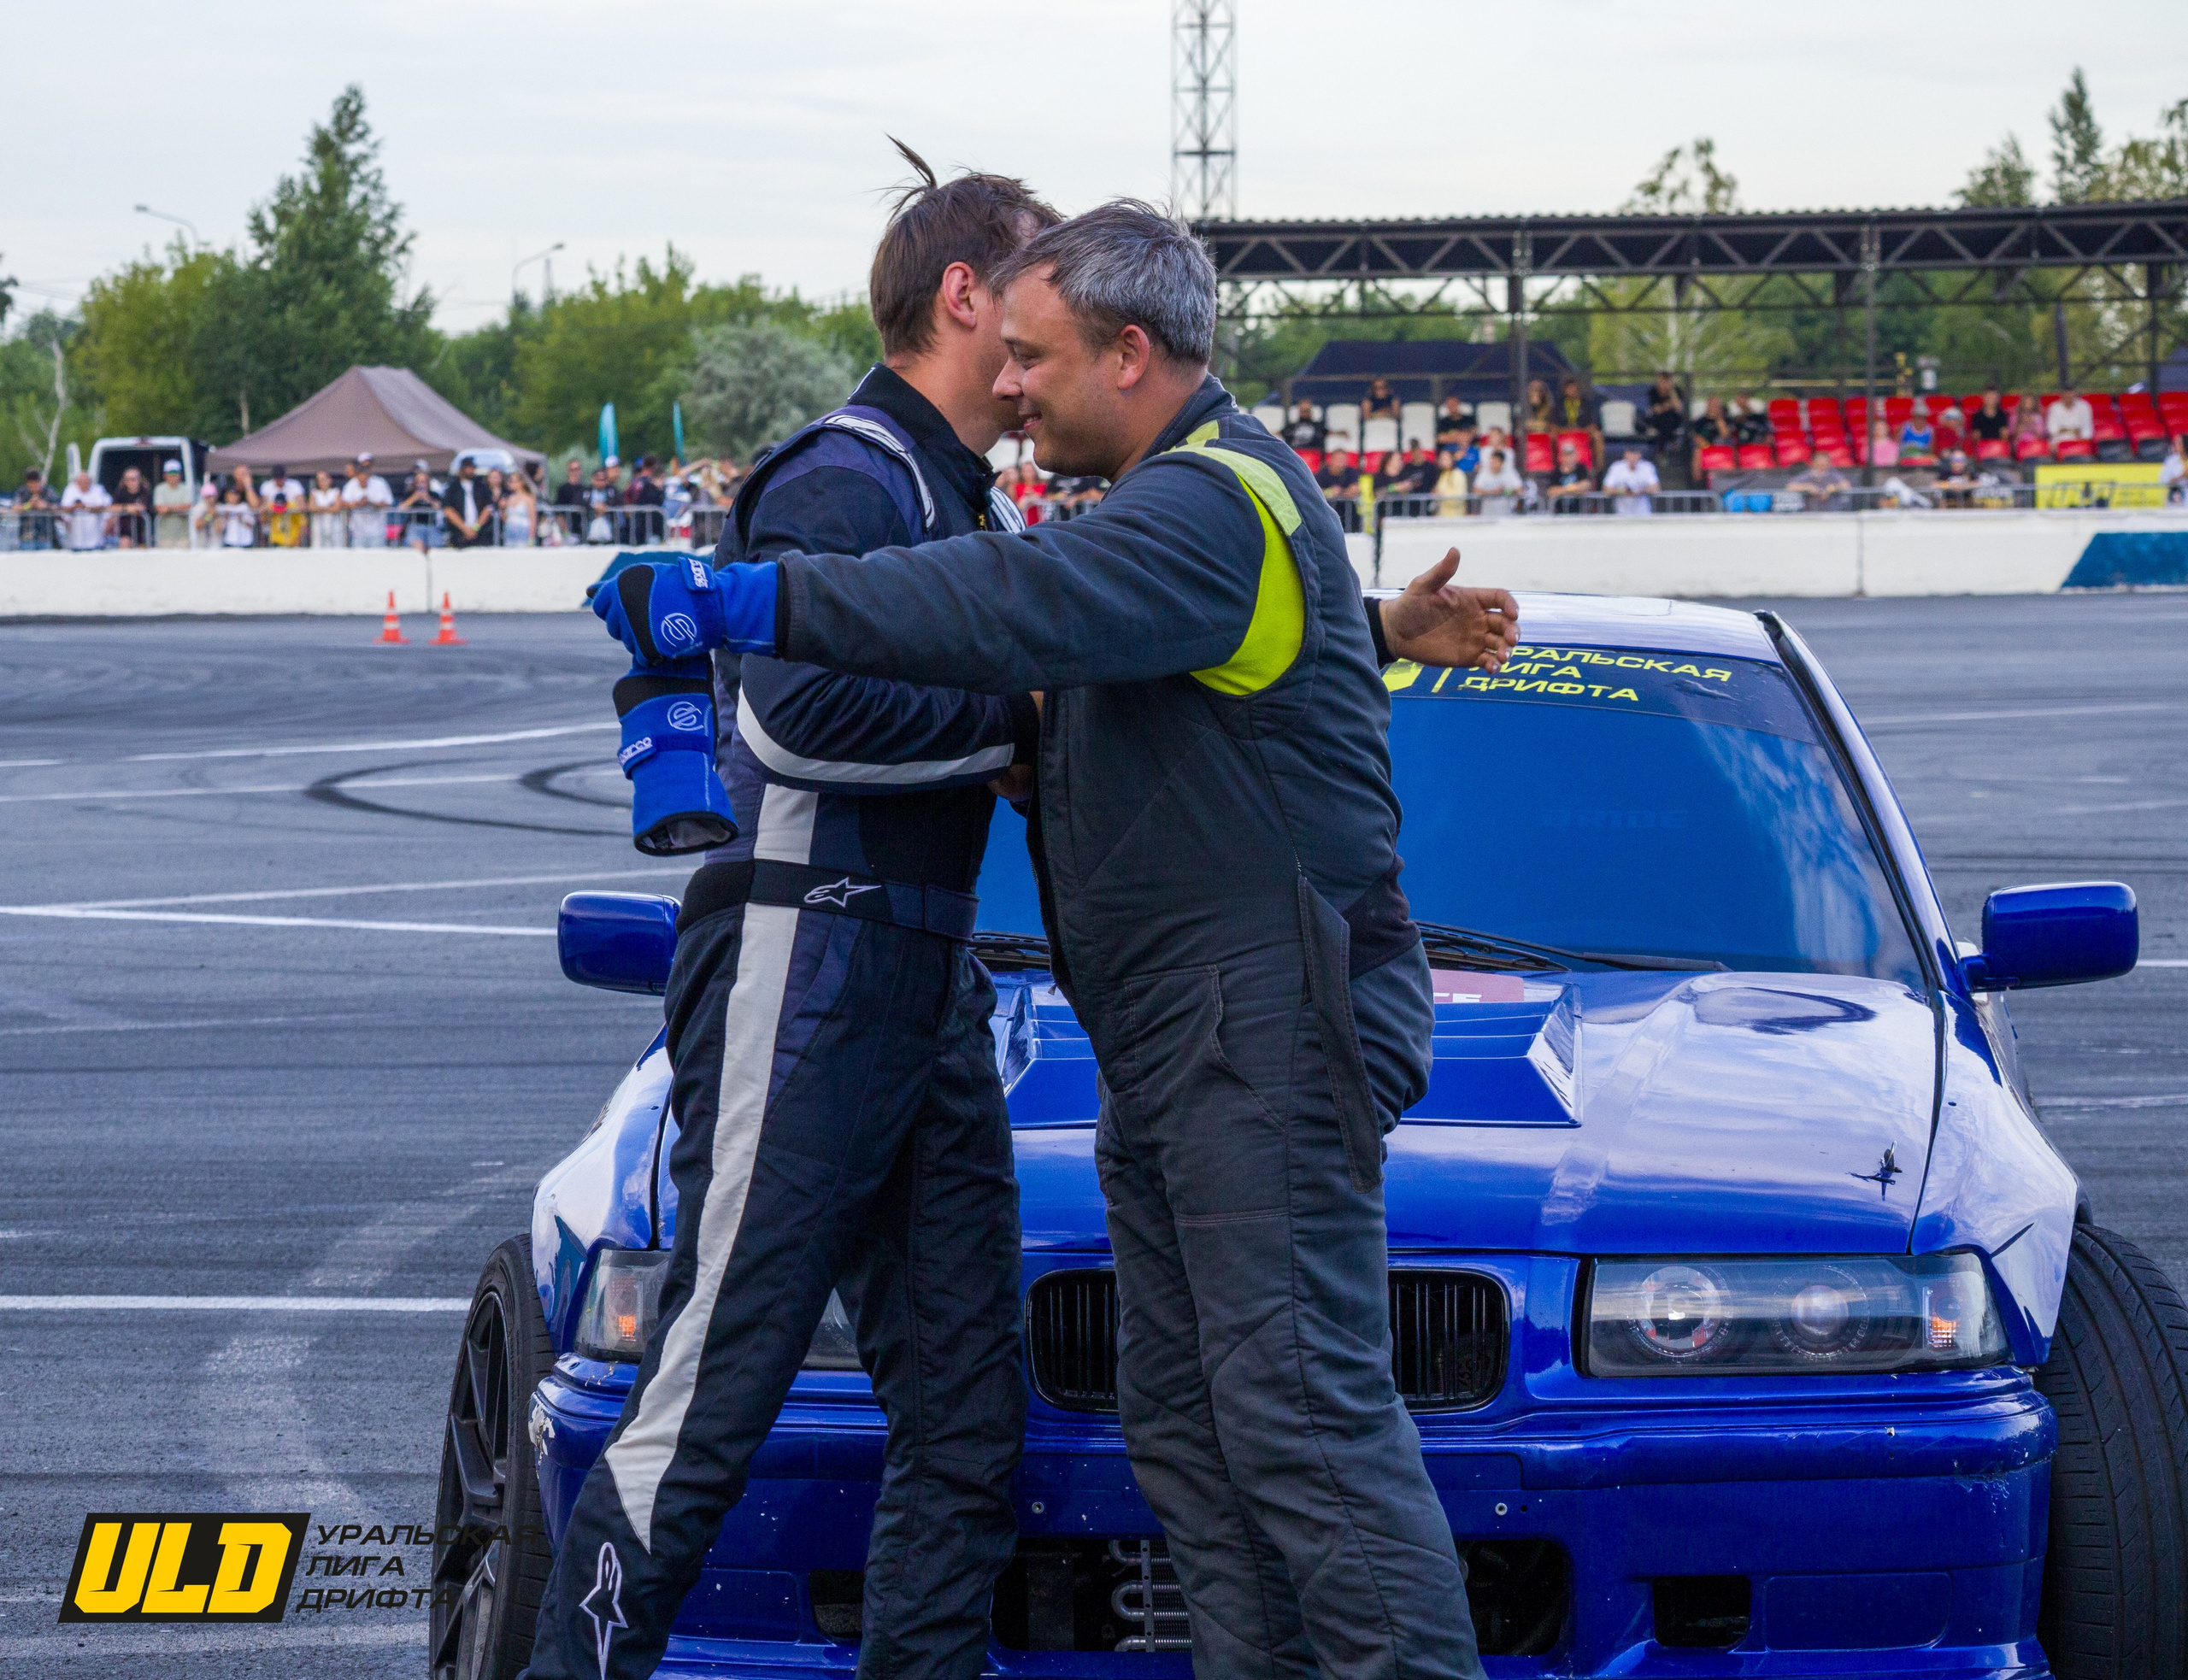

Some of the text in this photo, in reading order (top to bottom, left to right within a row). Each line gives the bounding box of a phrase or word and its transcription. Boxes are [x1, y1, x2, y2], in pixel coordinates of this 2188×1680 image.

[688, 558, 709, 588] sparc
[1468, 661, 1581, 679] ИГА
[1487, 647, 1732, 682] РАЛЬСКАЯ
[1457, 677, 1639, 702] ДРИФТА
